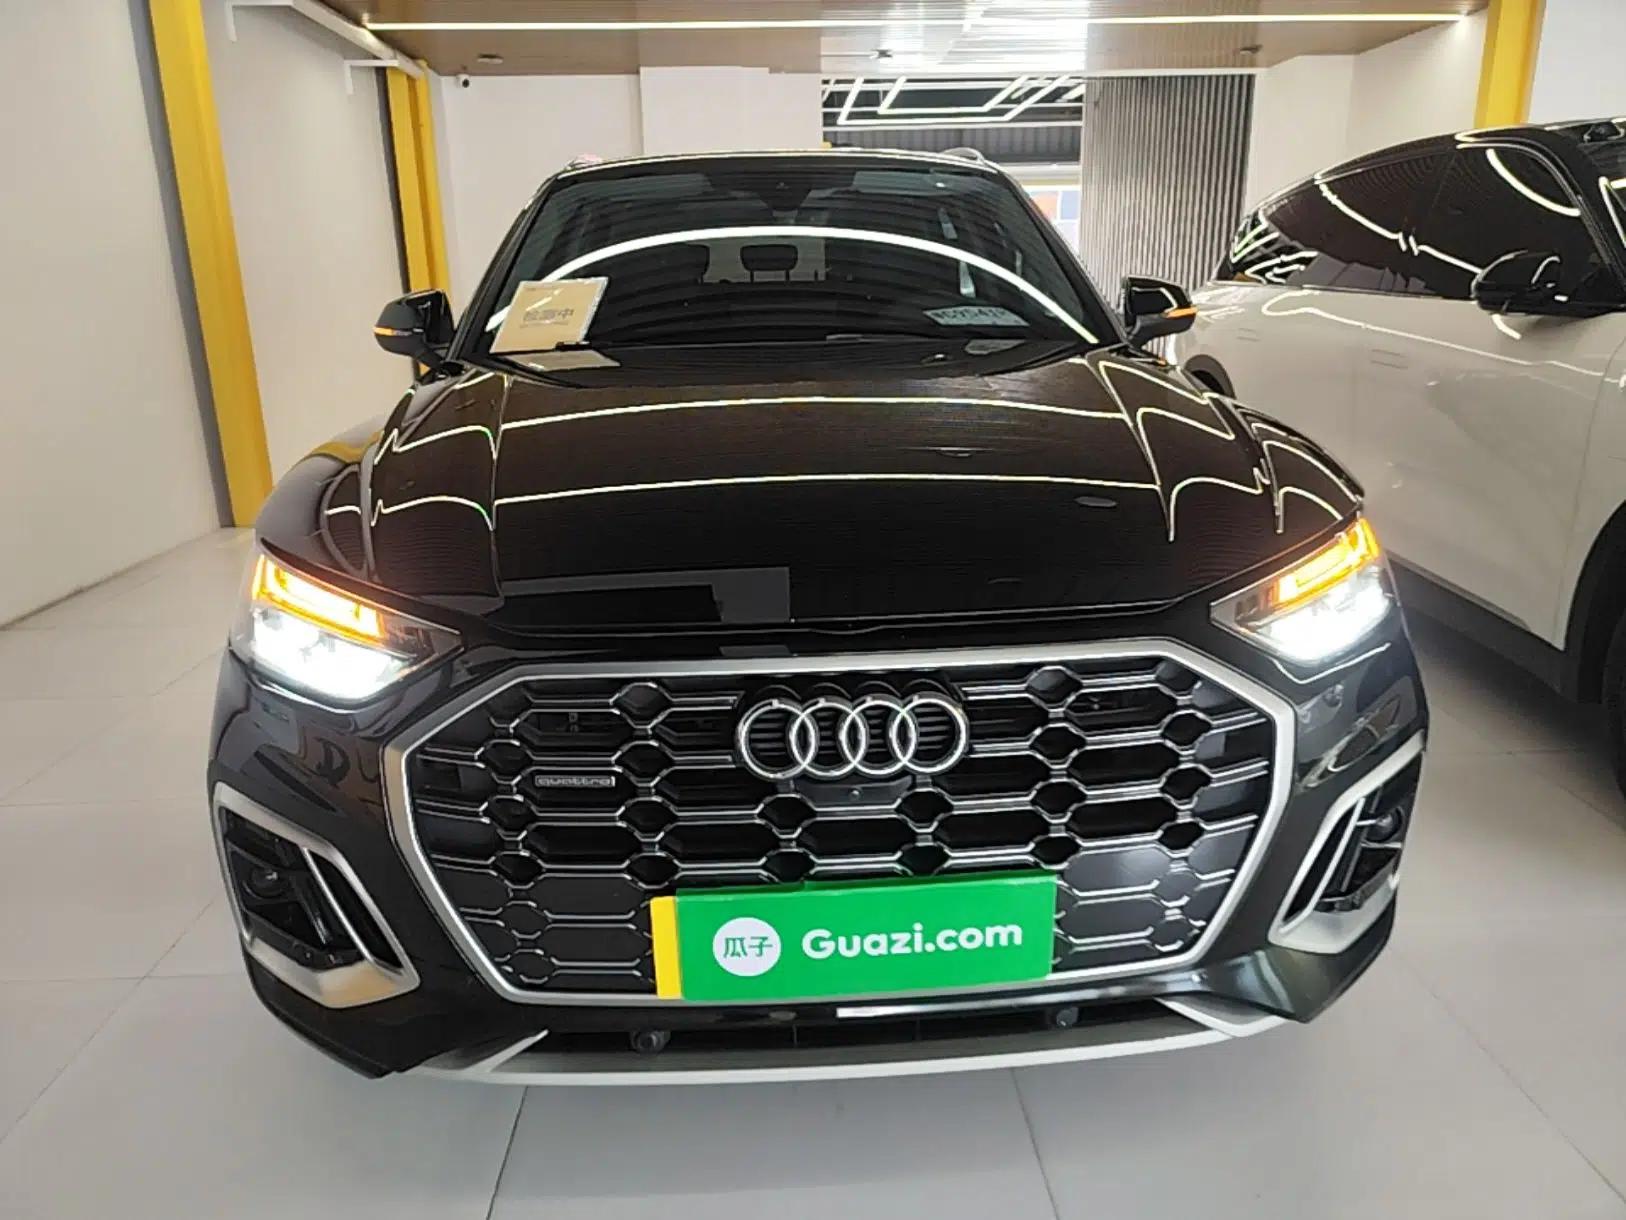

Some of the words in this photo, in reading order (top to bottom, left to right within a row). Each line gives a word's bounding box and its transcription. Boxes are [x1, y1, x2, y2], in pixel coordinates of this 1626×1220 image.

[537, 777, 612, 787] quattro
[724, 936, 774, 959] 瓜子
[803, 922, 1023, 960] Guazi.com
